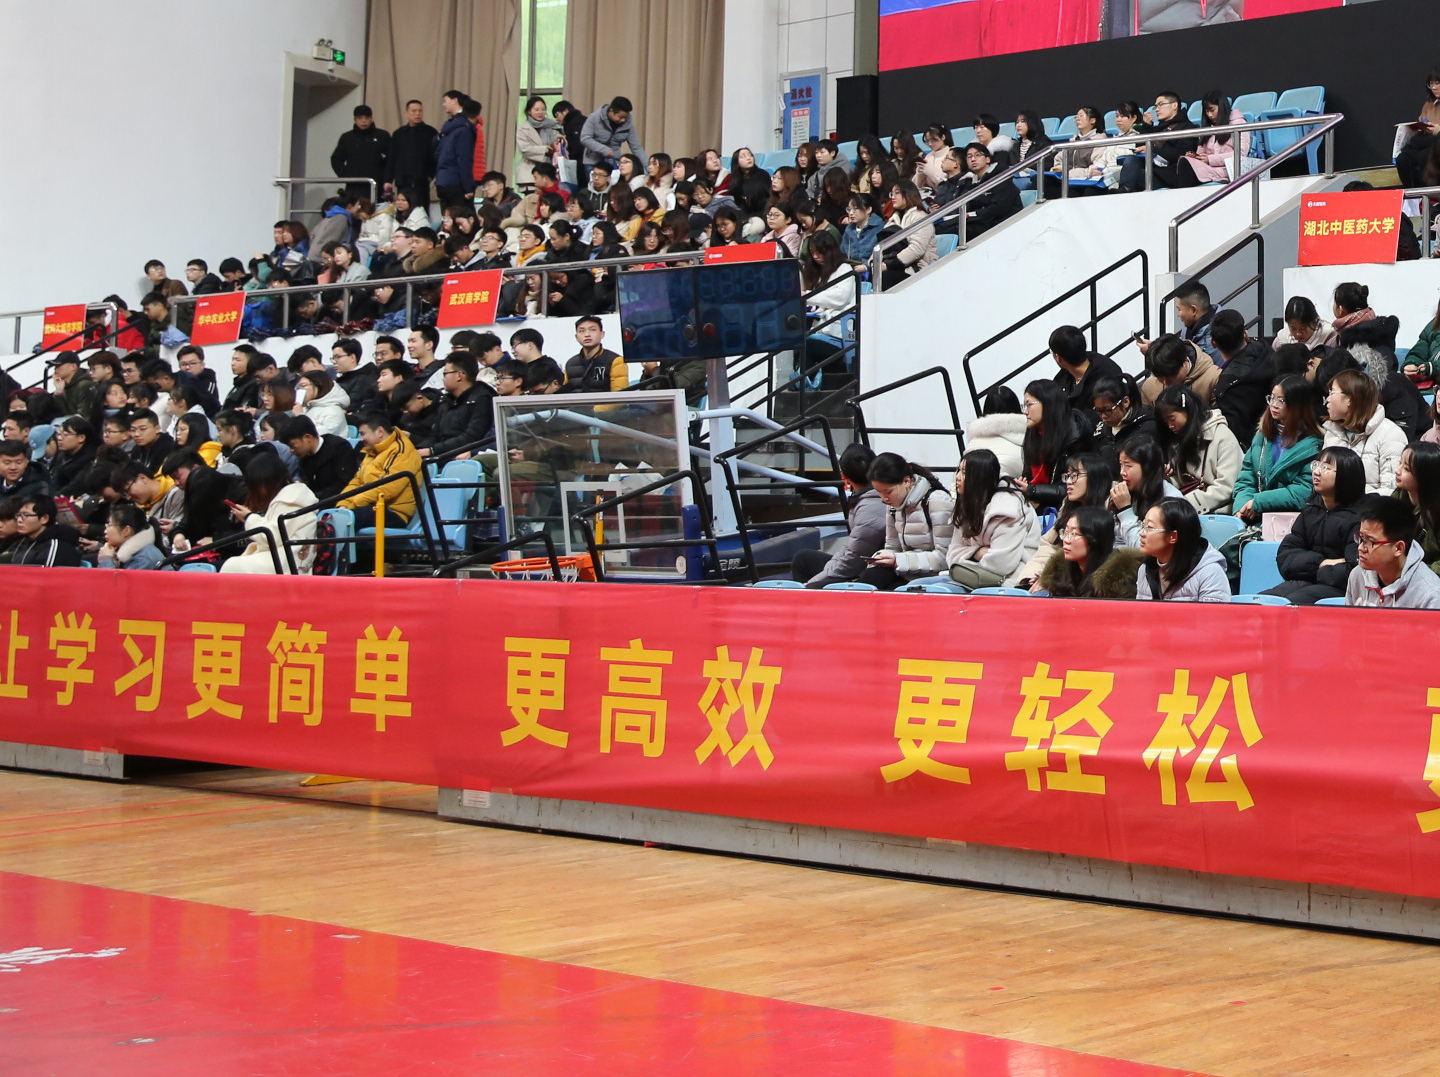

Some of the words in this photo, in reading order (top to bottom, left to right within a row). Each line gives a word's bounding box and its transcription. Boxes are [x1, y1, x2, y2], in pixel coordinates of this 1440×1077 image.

[1304, 217, 1395, 236] 湖北中医药大学
[449, 290, 489, 305] 武汉商学院
[500, 637, 783, 771] 更高效
[880, 659, 1264, 811] 更轻松
